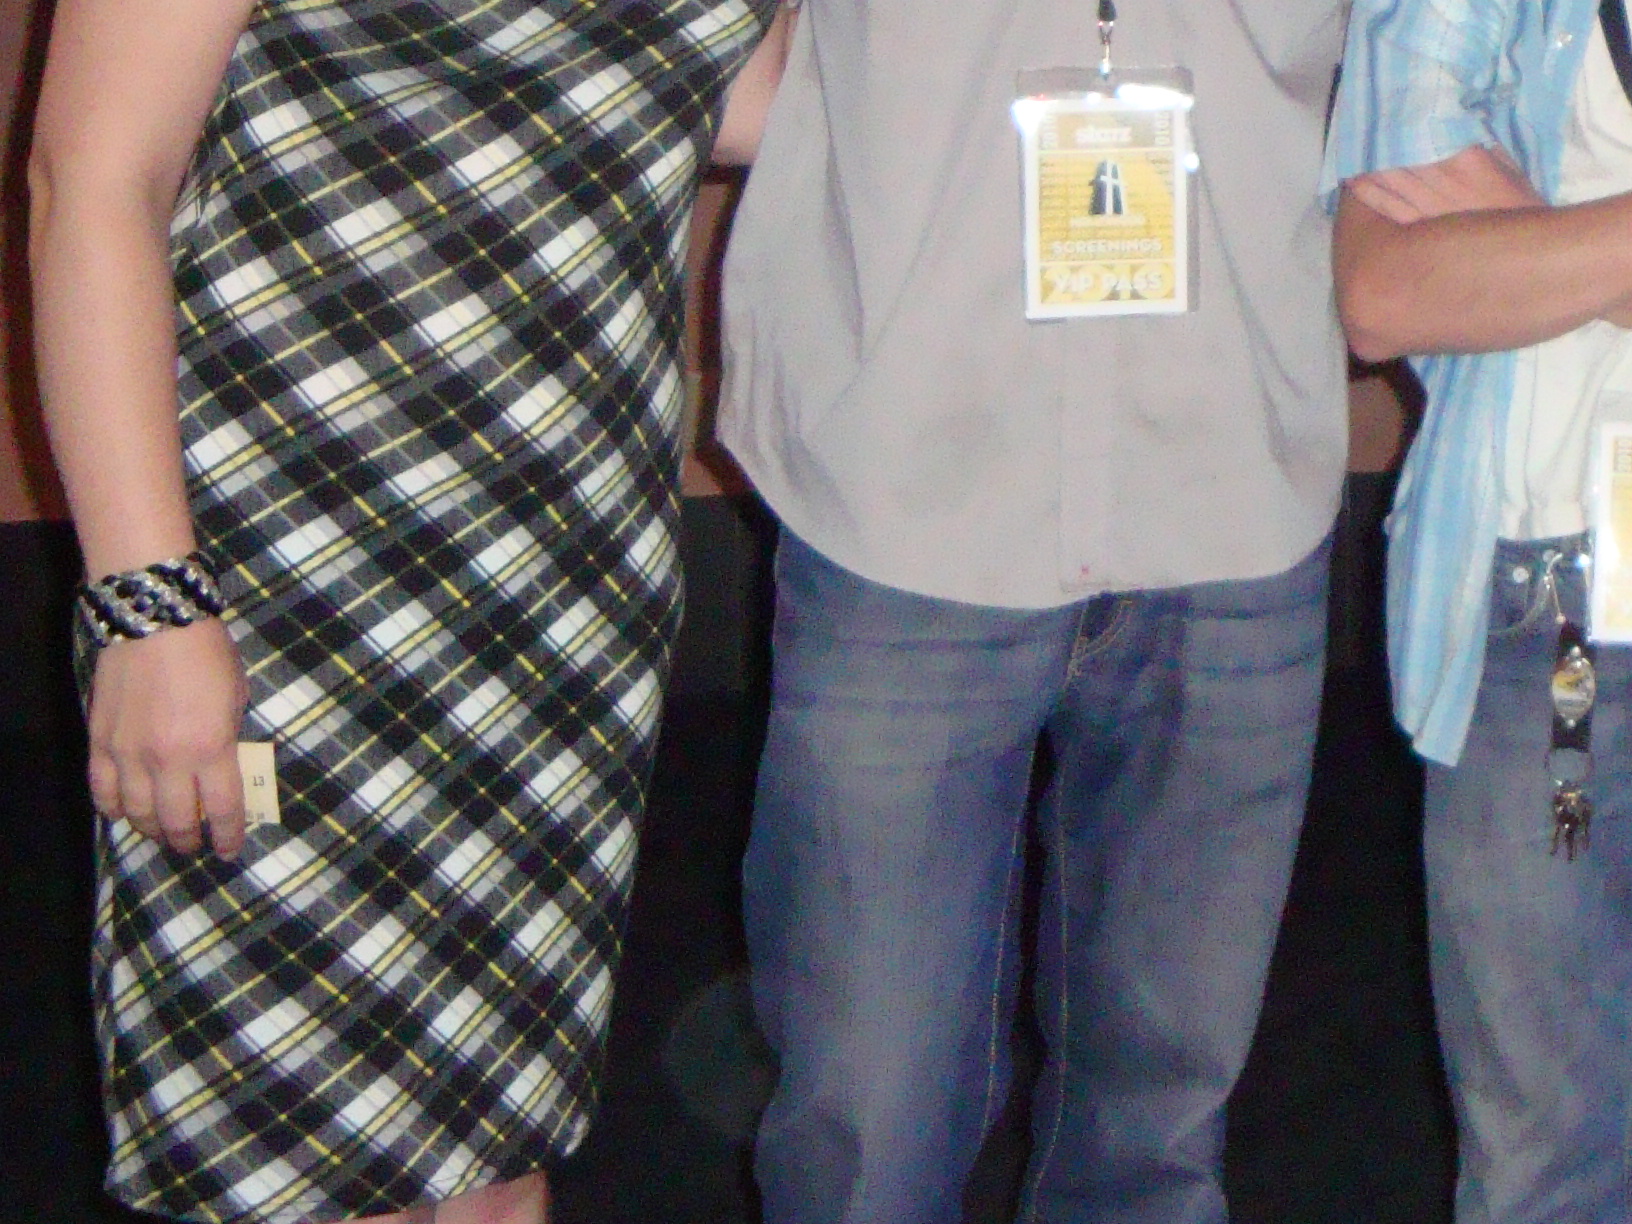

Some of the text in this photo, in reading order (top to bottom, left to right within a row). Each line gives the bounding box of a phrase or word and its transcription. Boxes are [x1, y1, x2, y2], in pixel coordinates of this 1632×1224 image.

[1052, 238, 1162, 255] SCREENINGS
[1054, 270, 1163, 292] VIP PASS
[253, 776, 265, 786] 13
